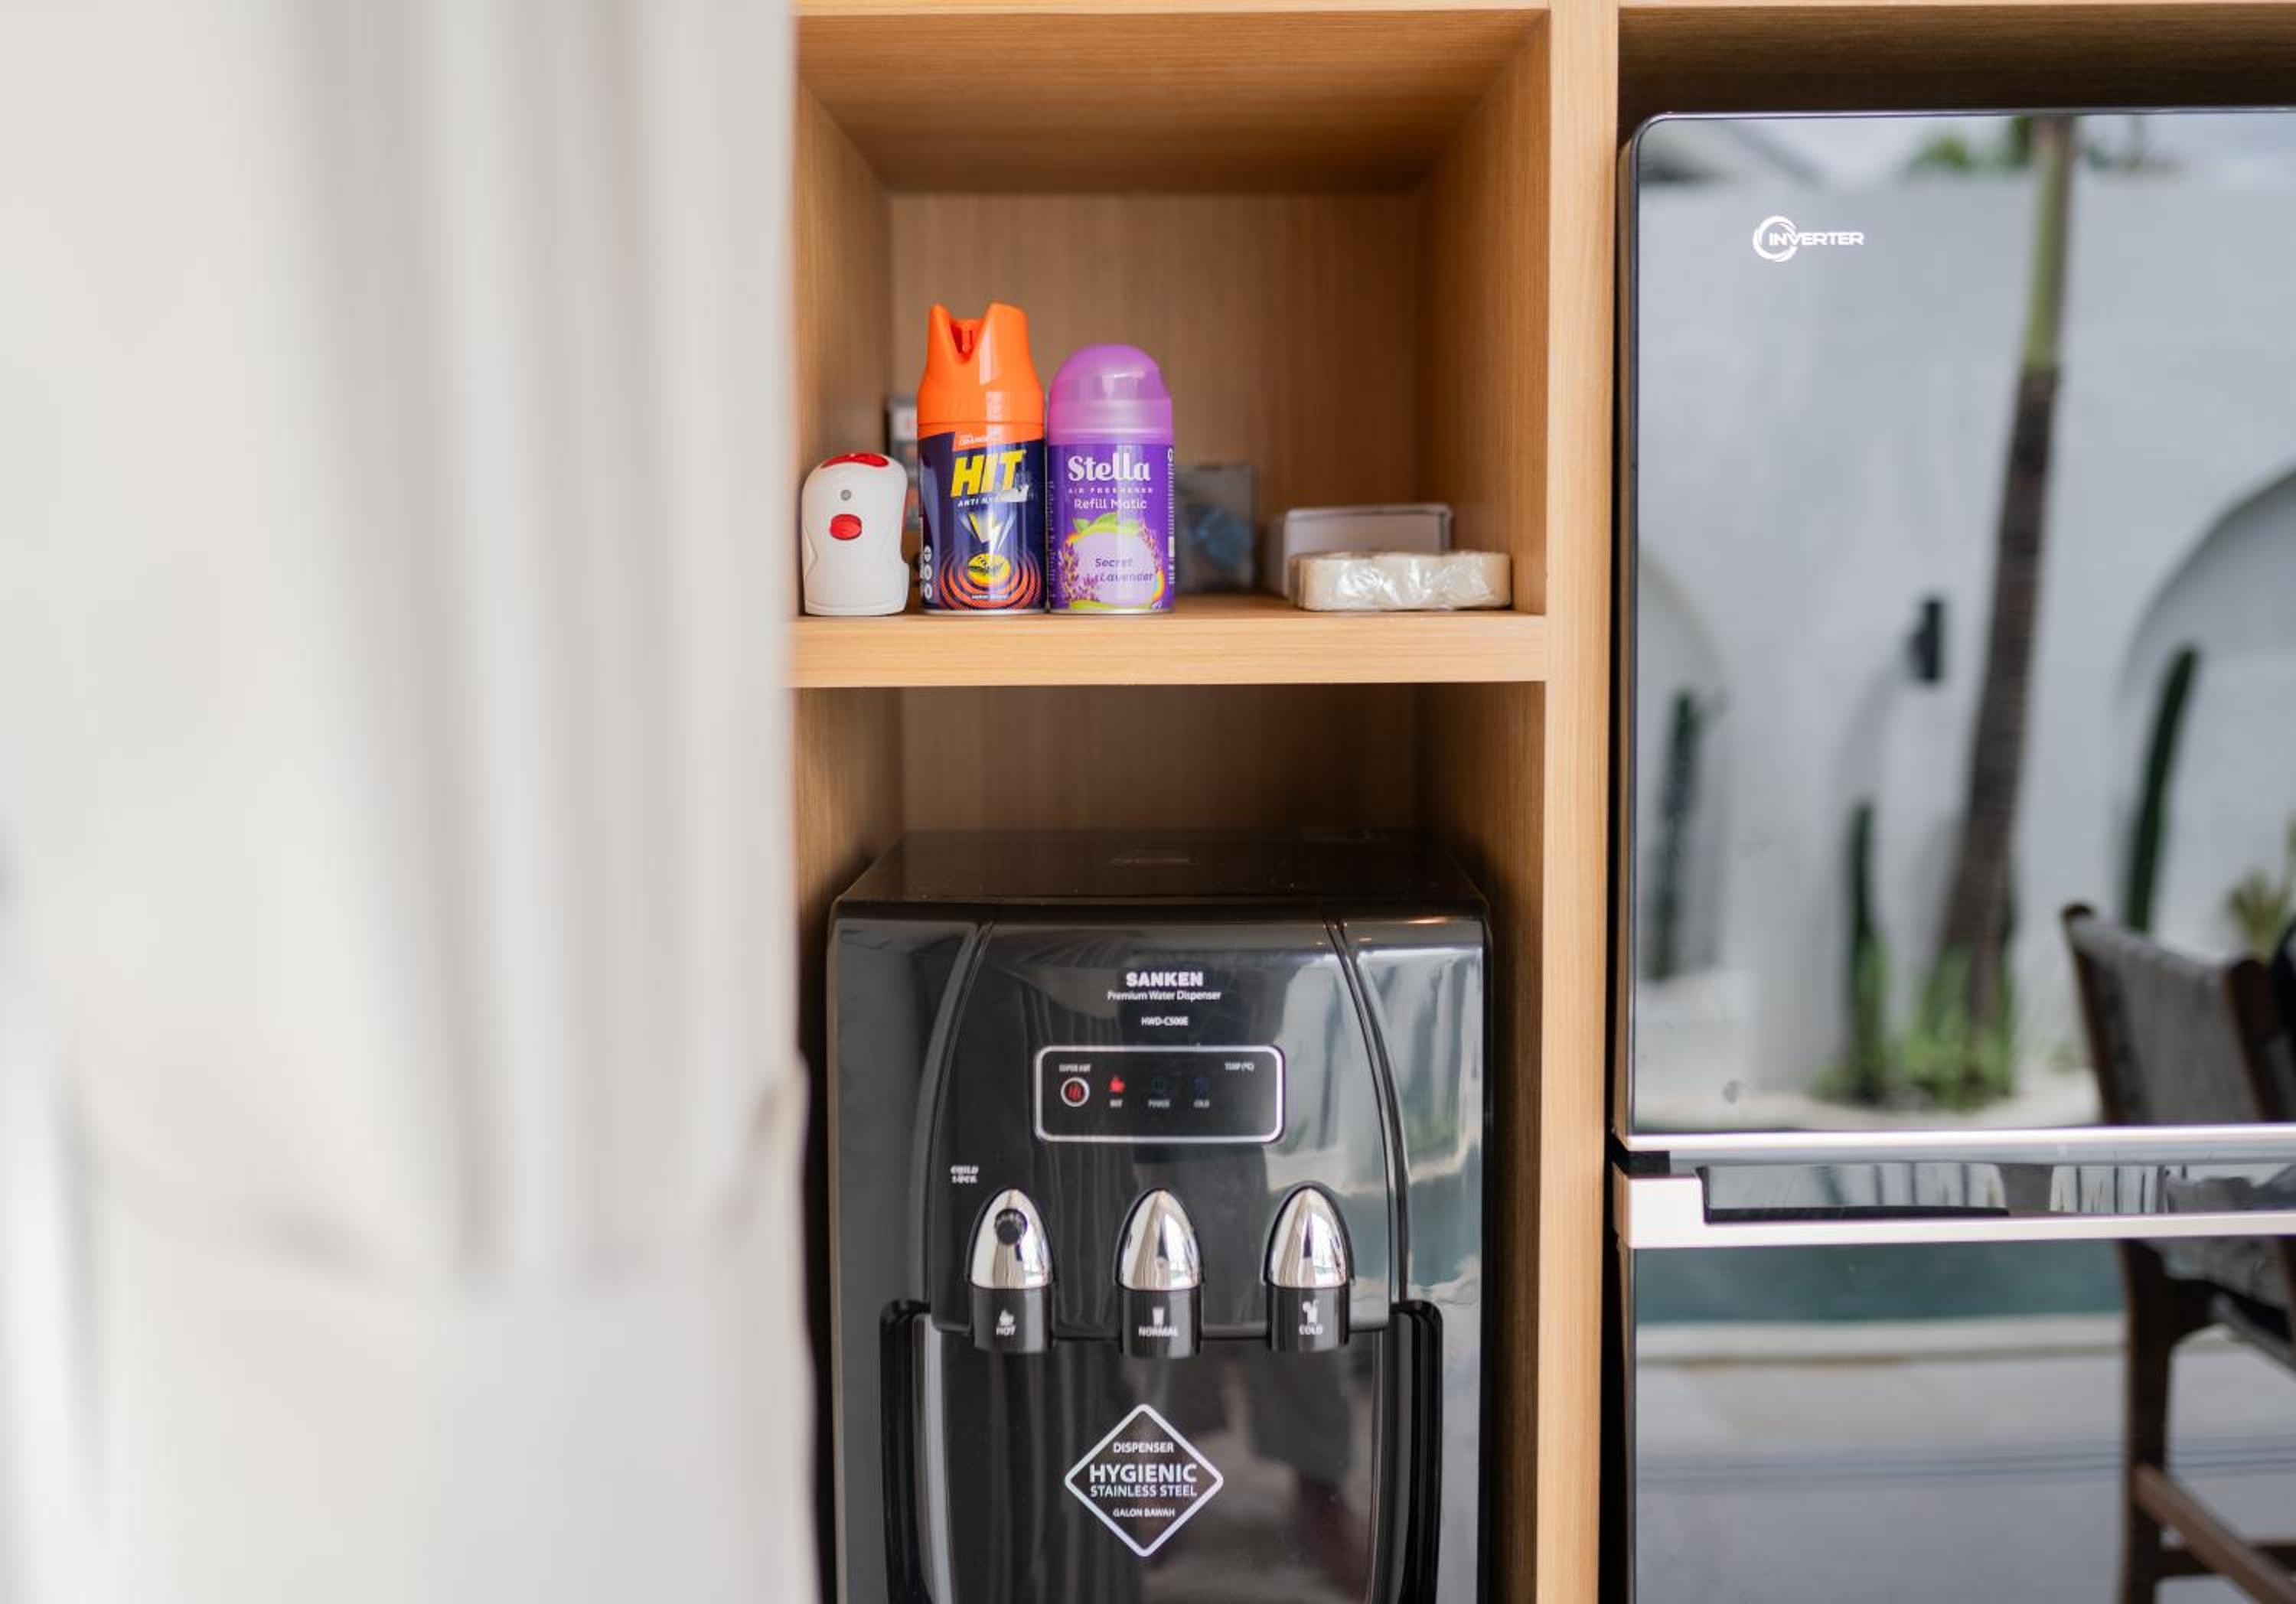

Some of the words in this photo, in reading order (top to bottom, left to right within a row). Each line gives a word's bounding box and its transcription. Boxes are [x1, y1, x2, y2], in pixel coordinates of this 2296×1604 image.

[1769, 232, 1864, 246] INVERTER
[1068, 452, 1152, 481] Stella
[951, 449, 1026, 497] HIT
[1074, 498, 1107, 510] Refill
[1110, 498, 1148, 510] Matic
[1126, 971, 1204, 987] SANKEN
[1107, 990, 1148, 1000] Premium
[1149, 990, 1176, 1000] Water
[1176, 990, 1221, 1002] Dispenser
[996, 1325, 1016, 1336] HOT
[1139, 1325, 1179, 1337] NORMAL
[1299, 1325, 1323, 1335] COLD
[1112, 1442, 1174, 1453] DISPENSER
[1089, 1463, 1198, 1483] HYGIENIC
[1090, 1485, 1156, 1498] STAINLESS
[1159, 1485, 1197, 1498] STEEL
[1112, 1508, 1143, 1518] GALON
[1144, 1508, 1176, 1518] BAWAH
